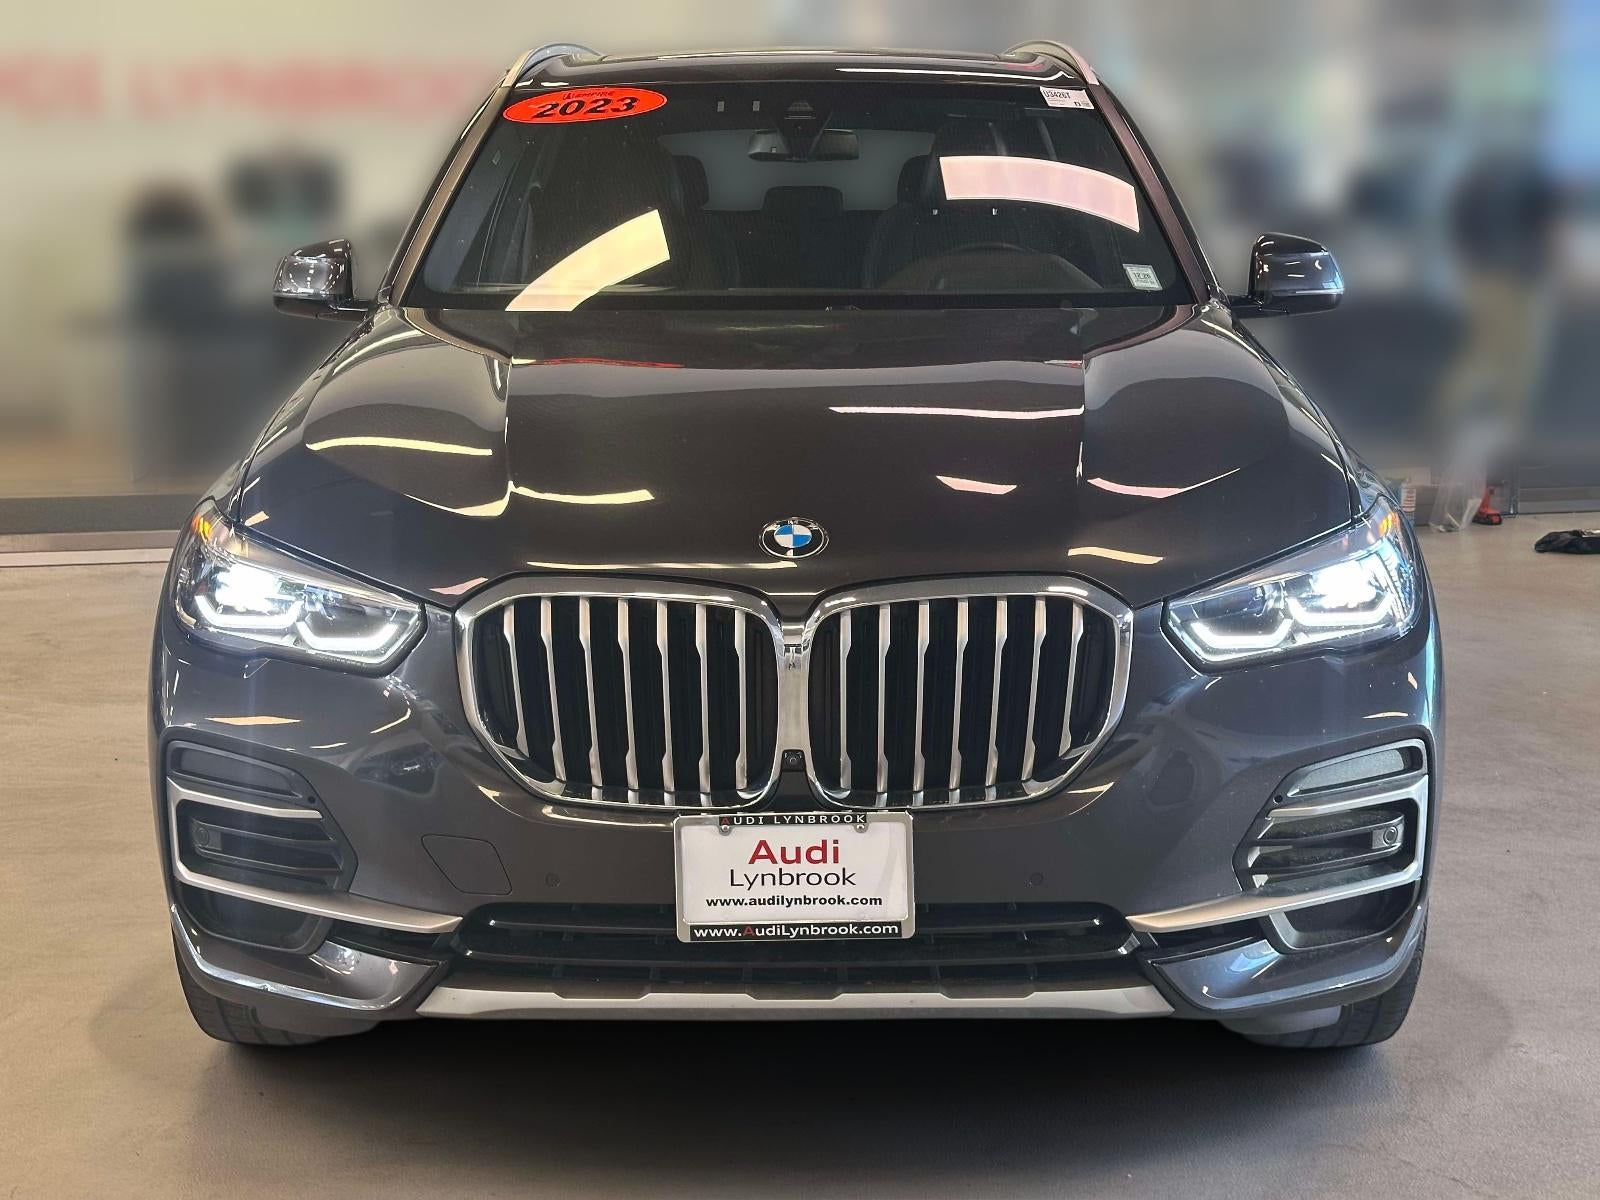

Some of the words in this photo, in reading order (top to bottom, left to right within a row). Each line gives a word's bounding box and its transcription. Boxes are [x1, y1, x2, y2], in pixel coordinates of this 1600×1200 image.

[531, 96, 640, 119] 2023
[720, 816, 764, 826] AUDI
[774, 814, 866, 825] LYNBROOK
[748, 839, 840, 865] Audi
[729, 867, 857, 891] Lynbrook
[706, 894, 883, 908] www.audilynbrook.com
[693, 923, 899, 938] www.AudiLynbrook.com
